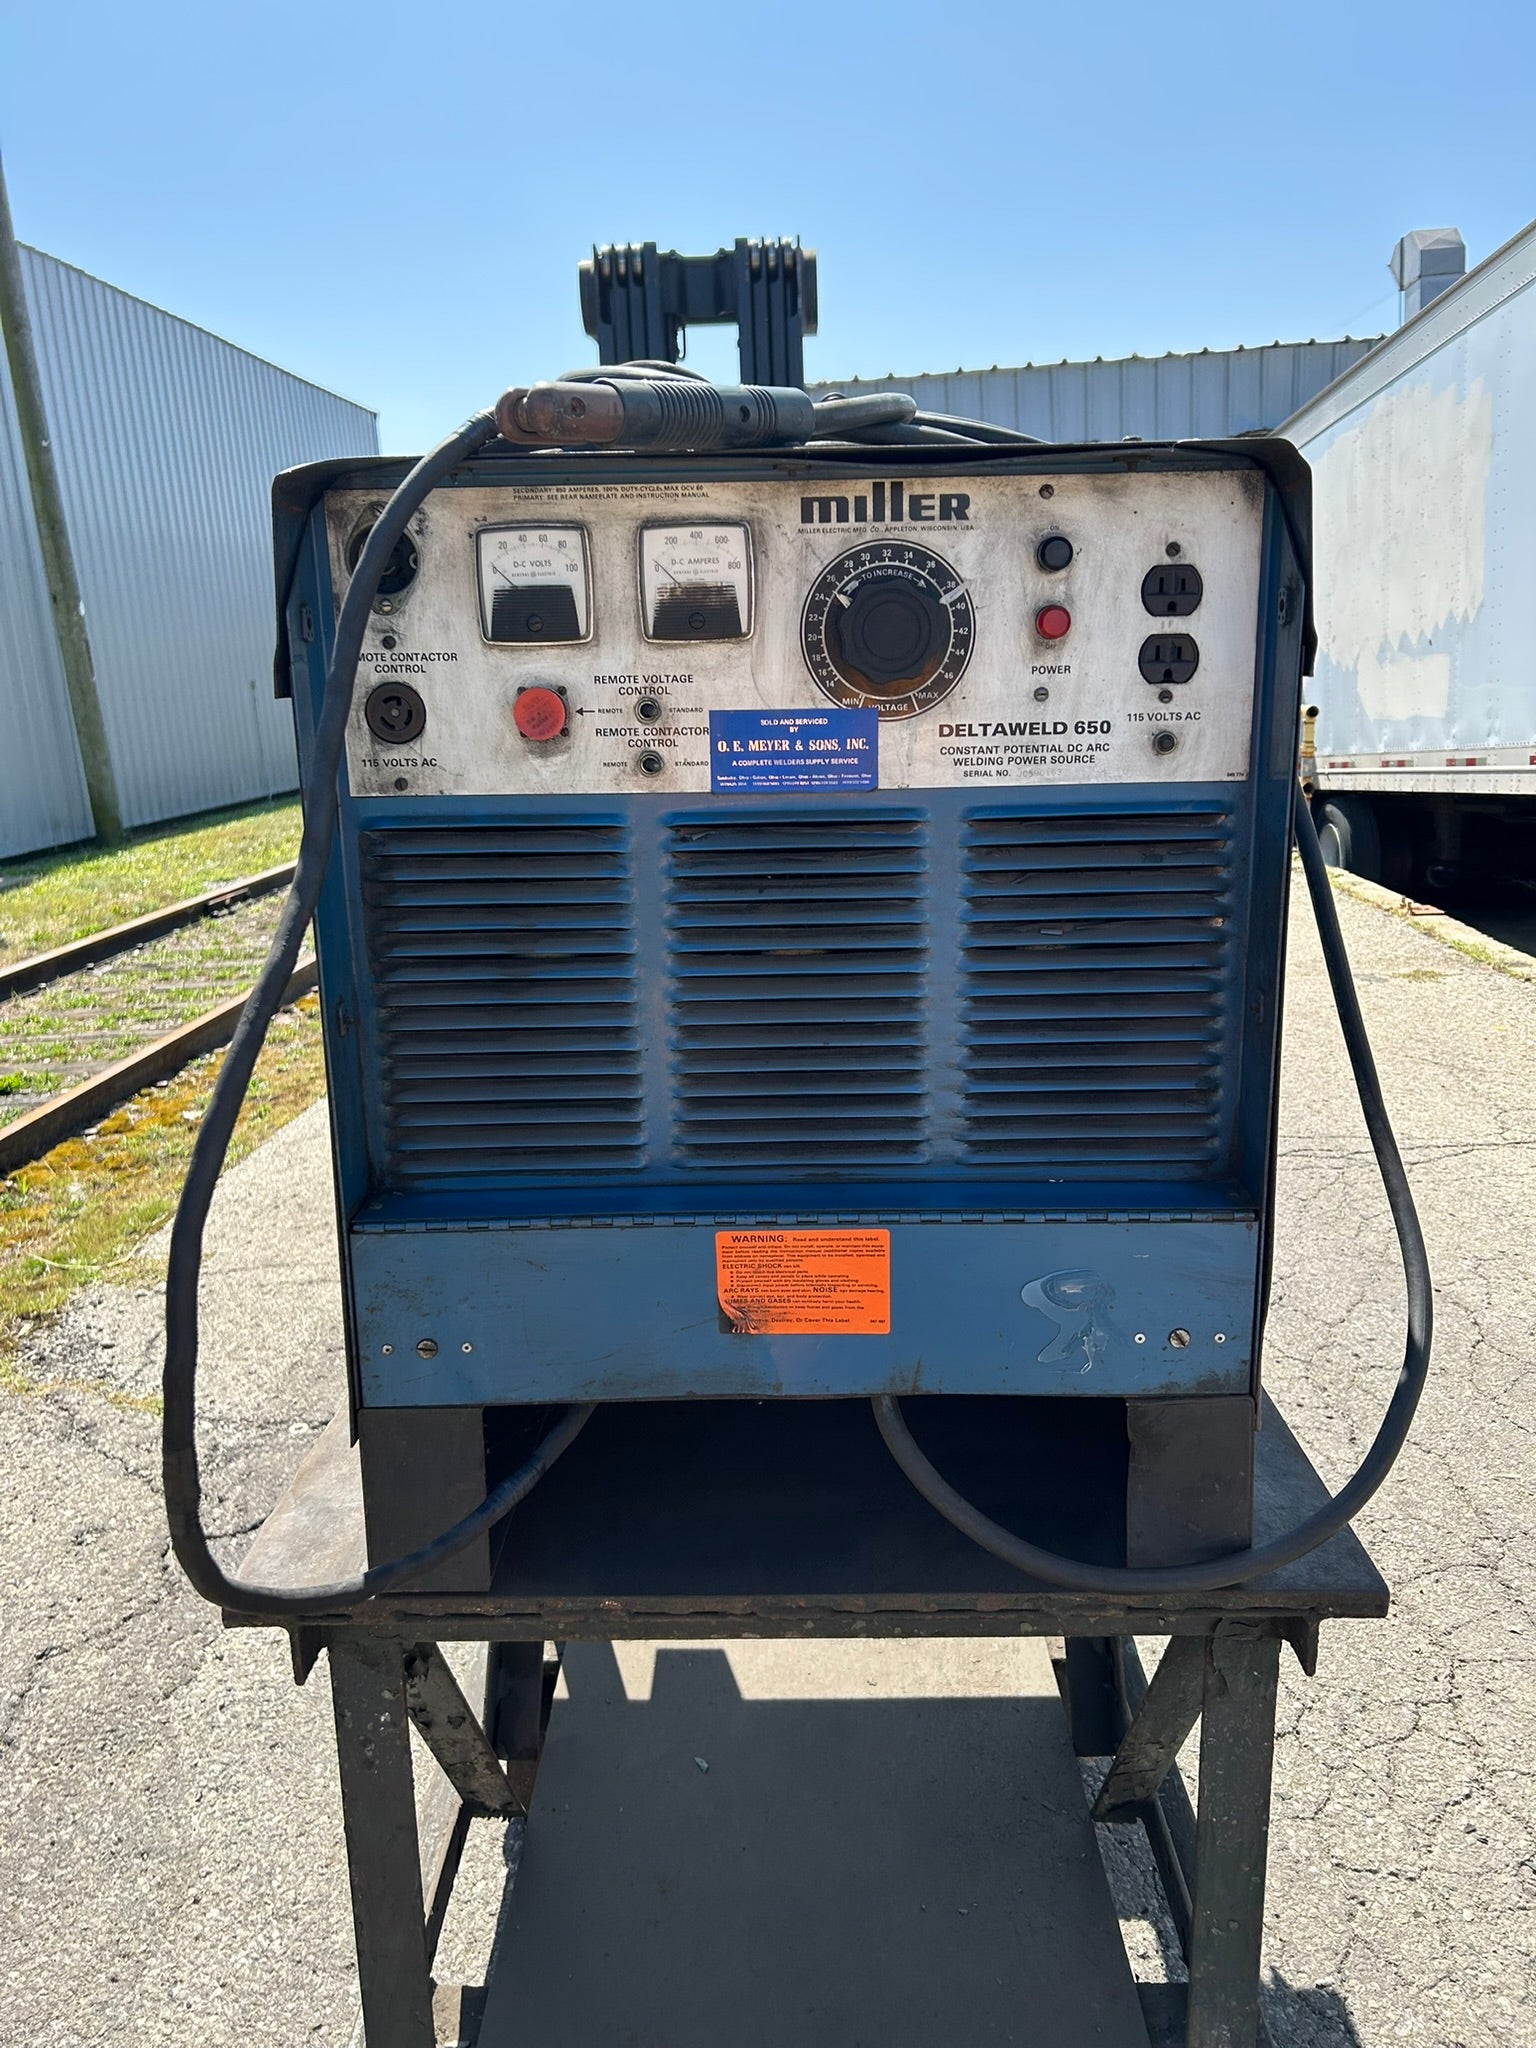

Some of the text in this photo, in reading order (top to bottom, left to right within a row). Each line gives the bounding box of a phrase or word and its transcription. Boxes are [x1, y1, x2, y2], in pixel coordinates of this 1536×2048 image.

[636, 491, 679, 499] INSTRUCTION
[498, 541, 508, 550] 20
[519, 534, 527, 543] 40
[538, 534, 548, 543] 60
[558, 540, 567, 549] 80
[565, 563, 578, 572] 100
[664, 536, 678, 545] 200
[690, 531, 703, 539] 400
[714, 535, 728, 544] 600
[727, 561, 741, 569] 800
[882, 549, 892, 557] 32
[860, 553, 871, 561] 30
[903, 551, 914, 560] 34
[529, 560, 552, 568] VOLTS
[687, 557, 720, 565] AMPERES
[843, 560, 854, 568] 28
[926, 560, 936, 569] 36
[826, 574, 836, 583] 26
[861, 568, 914, 581] TO INCREASE
[946, 580, 956, 589] 38
[815, 592, 825, 601] 24
[956, 602, 966, 610] 40
[808, 614, 819, 622] 22
[958, 627, 969, 635] 42
[955, 648, 965, 656] 44
[359, 652, 458, 662] MOTE CONTACTOR
[812, 654, 821, 662] 18
[374, 664, 427, 674] CONTROL
[1031, 665, 1072, 675] POWER
[594, 674, 694, 685] REMOTE VOLTAGE
[944, 672, 954, 680] 46
[825, 680, 835, 688] 14
[618, 686, 671, 696] CONTROL
[917, 691, 939, 700] MAX
[842, 697, 860, 706] MIN
[1126, 711, 1201, 722] 115 VOLTS AC
[595, 726, 709, 737] REMOTE CONTACTOR
[938, 720, 1112, 738] DELTAWELD 650
[628, 738, 679, 748] CONTROL
[717, 738, 869, 752] O. E. MEYER & SONS, INC.
[940, 742, 1110, 756] CONSTANT POTENTIAL DC ARC
[361, 758, 437, 768] 115 VOLTS AC
[831, 757, 859, 765] SERVICE
[953, 754, 1095, 767] WELDING POWER SOURCE
[963, 769, 1012, 778] SERIAL NO.
[731, 1235, 788, 1243] WARNING:
